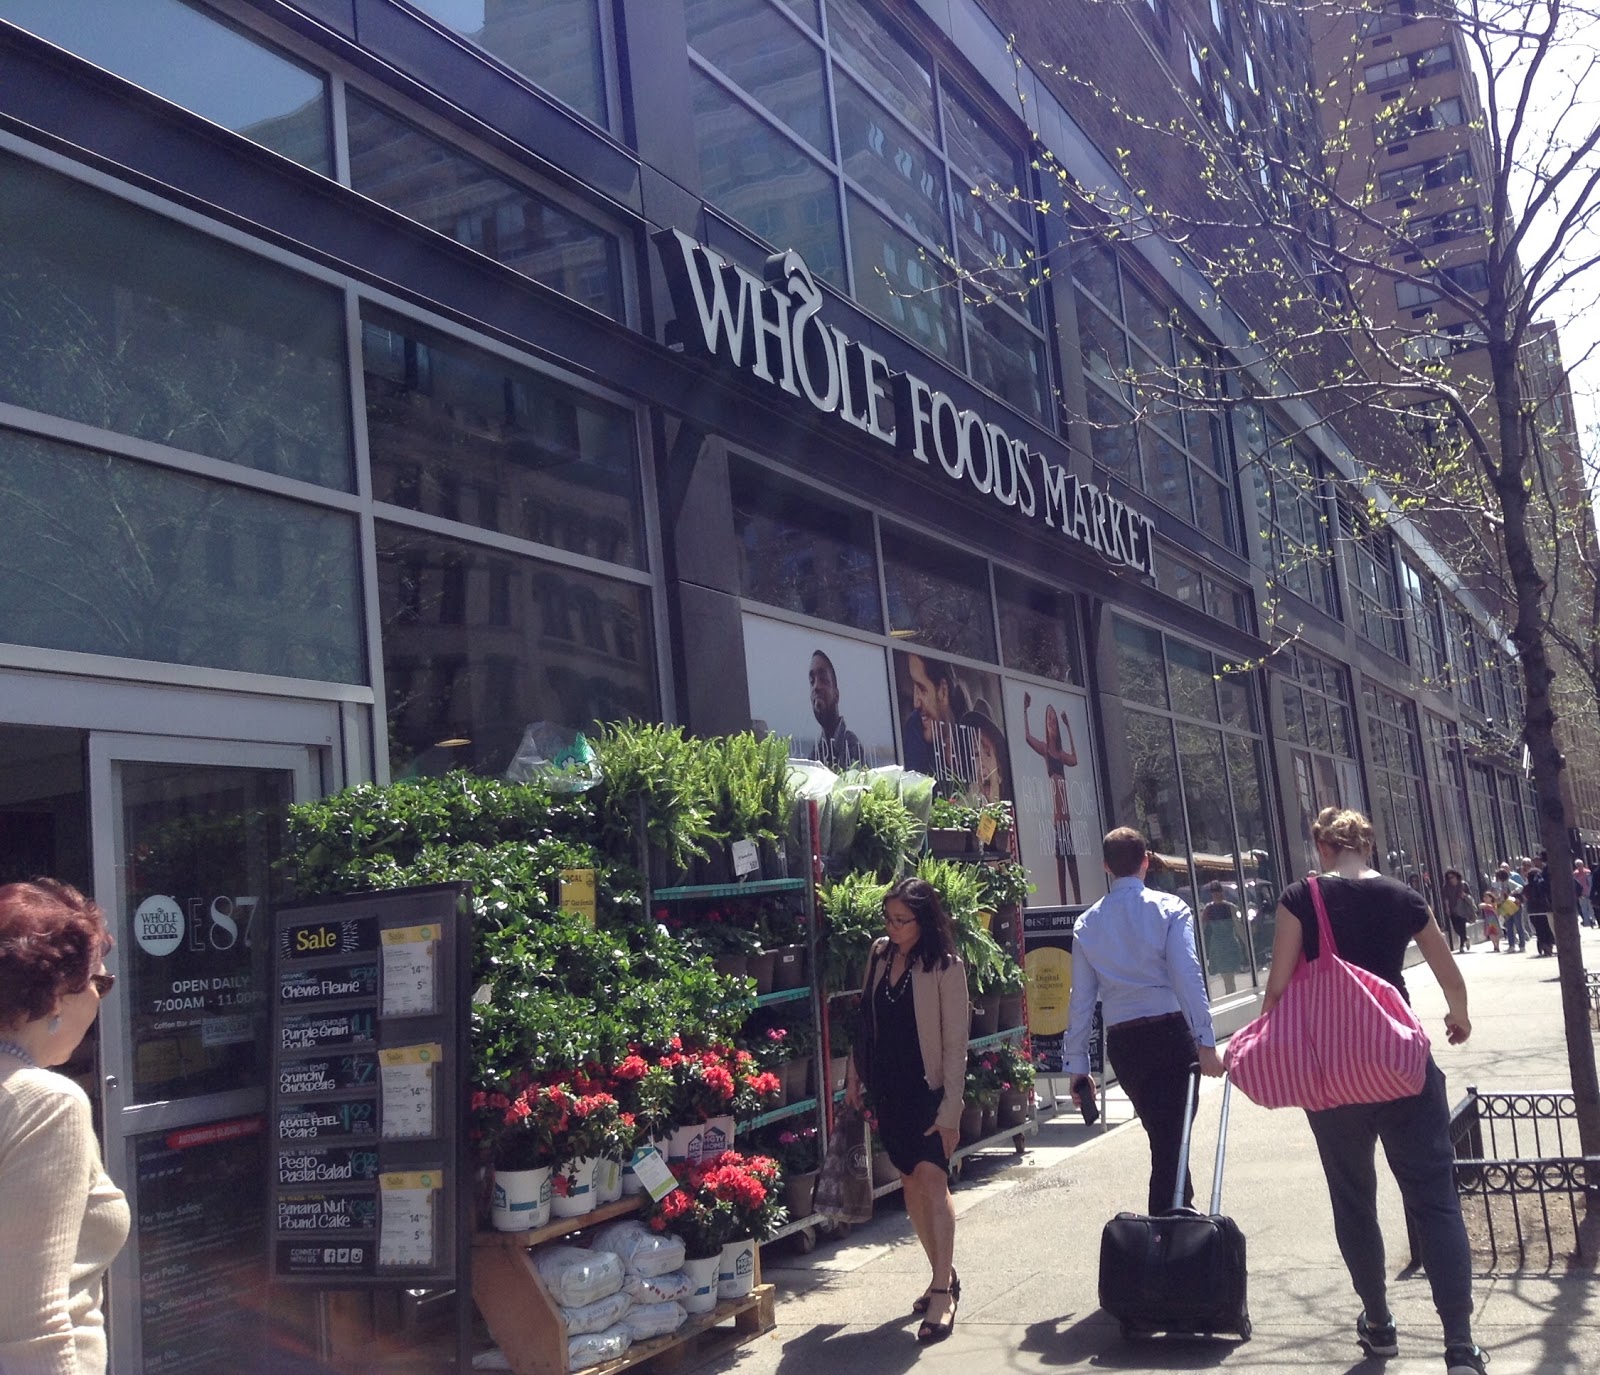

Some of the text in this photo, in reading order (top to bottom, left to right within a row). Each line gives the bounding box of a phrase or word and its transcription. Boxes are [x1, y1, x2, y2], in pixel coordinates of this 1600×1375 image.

[670, 226, 1157, 578] WHOLE FOODS MARKET
[141, 908, 178, 924] WHOLE
[1052, 916, 1071, 926] UPPER
[143, 923, 177, 935] FOODS
[296, 926, 337, 951] Sale
[172, 975, 249, 994] OPEN DAILY
[153, 996, 205, 1013] 7:00AM
[153, 1021, 175, 1030] Coffee
[176, 1020, 188, 1028] Bar
[282, 1025, 349, 1041] Purple Grain
[280, 1070, 326, 1083] Crunchy
[279, 1119, 310, 1128] ABATE
[279, 1156, 318, 1170] Pesto
[279, 1161, 352, 1182] Pasta Salad
[278, 1202, 321, 1215] Banana
[323, 1198, 347, 1213] Nut
[278, 1214, 317, 1229] Pound
[318, 1213, 351, 1229] Cake
[290, 1248, 321, 1256] CONNECT
[307, 1256, 317, 1264] US
